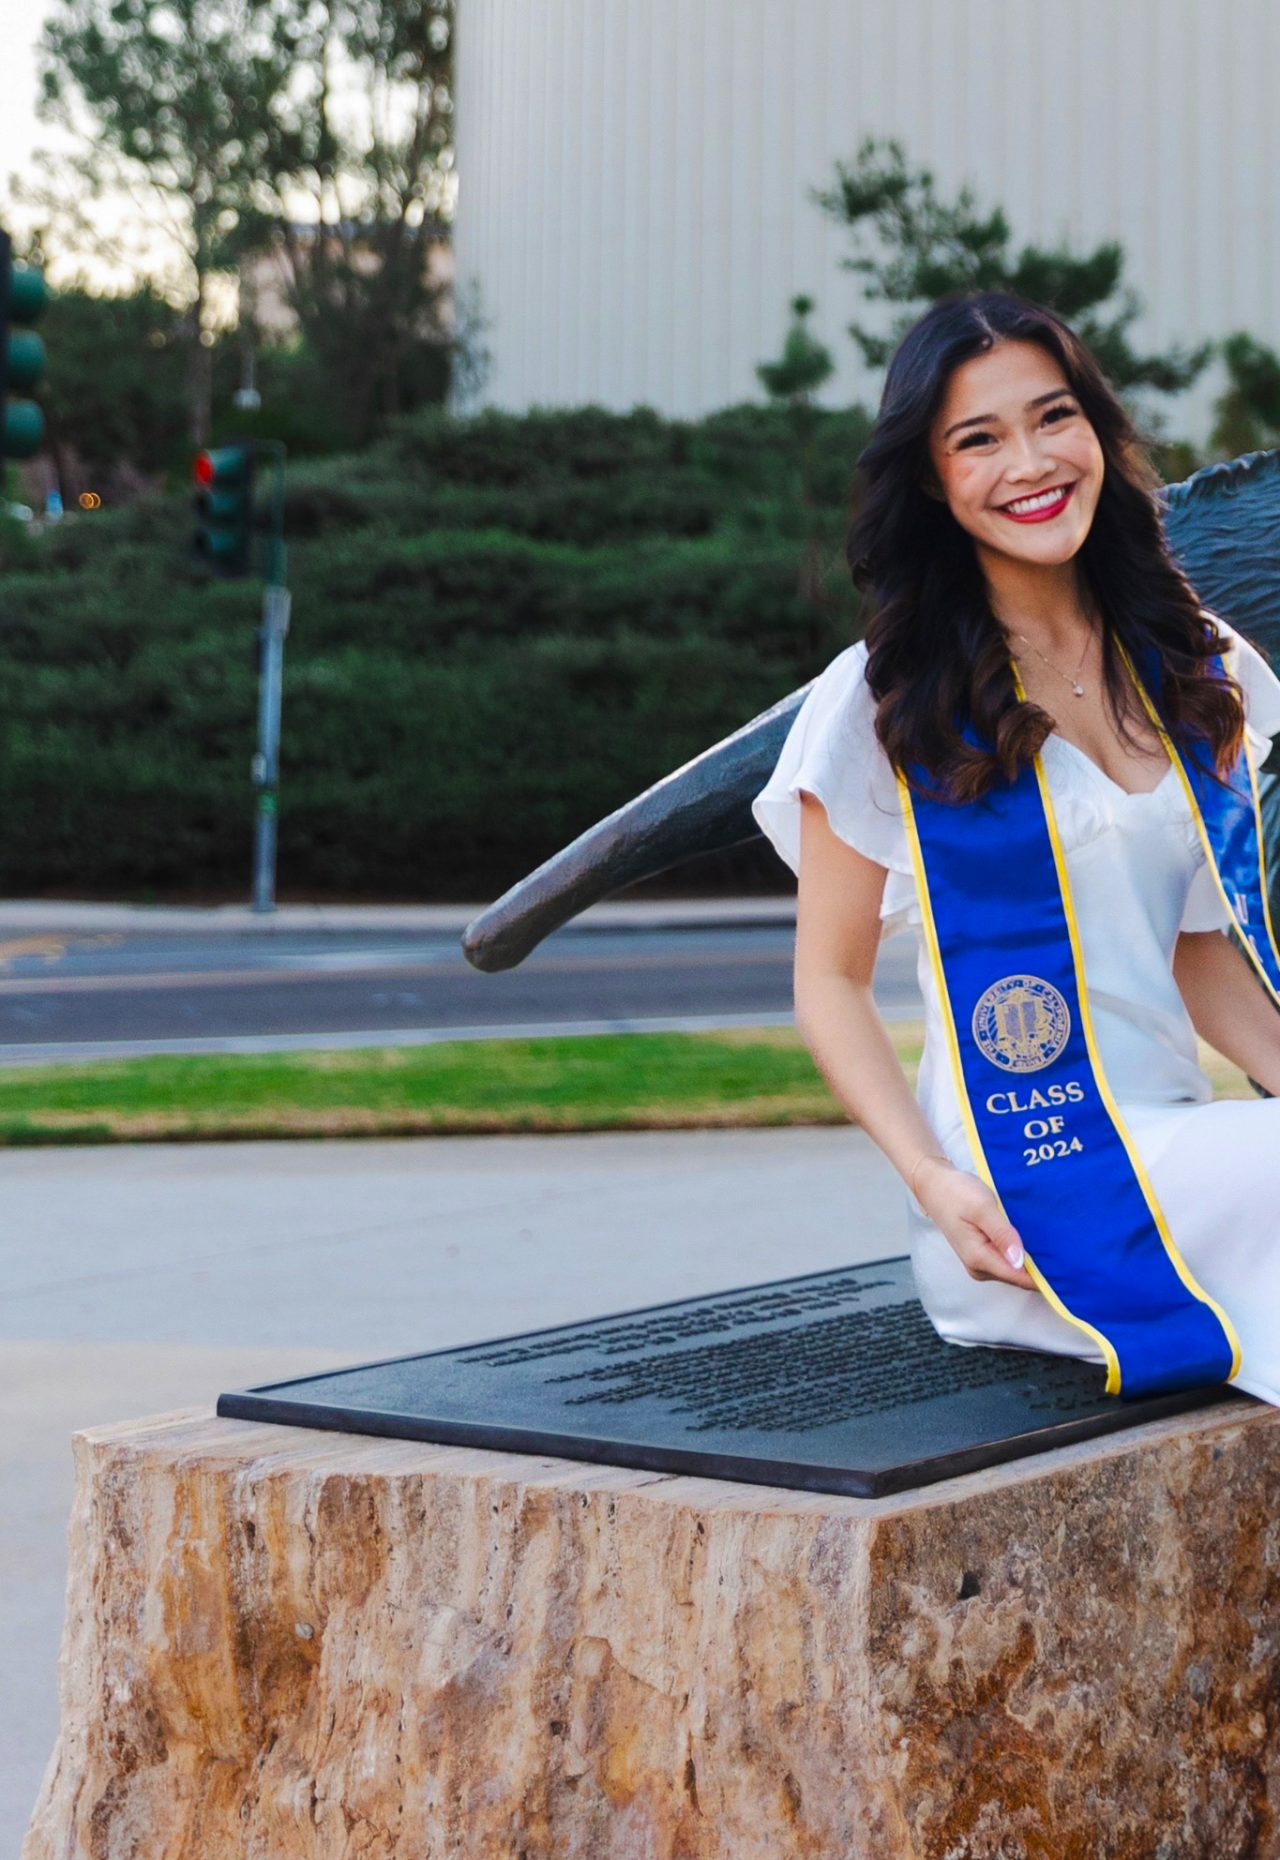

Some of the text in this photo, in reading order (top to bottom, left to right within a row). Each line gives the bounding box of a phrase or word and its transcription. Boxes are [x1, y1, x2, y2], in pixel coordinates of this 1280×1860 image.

[986, 1081, 1085, 1114] CLASS
[1023, 1116, 1065, 1139] OF
[1022, 1136, 1083, 1166] 2024
